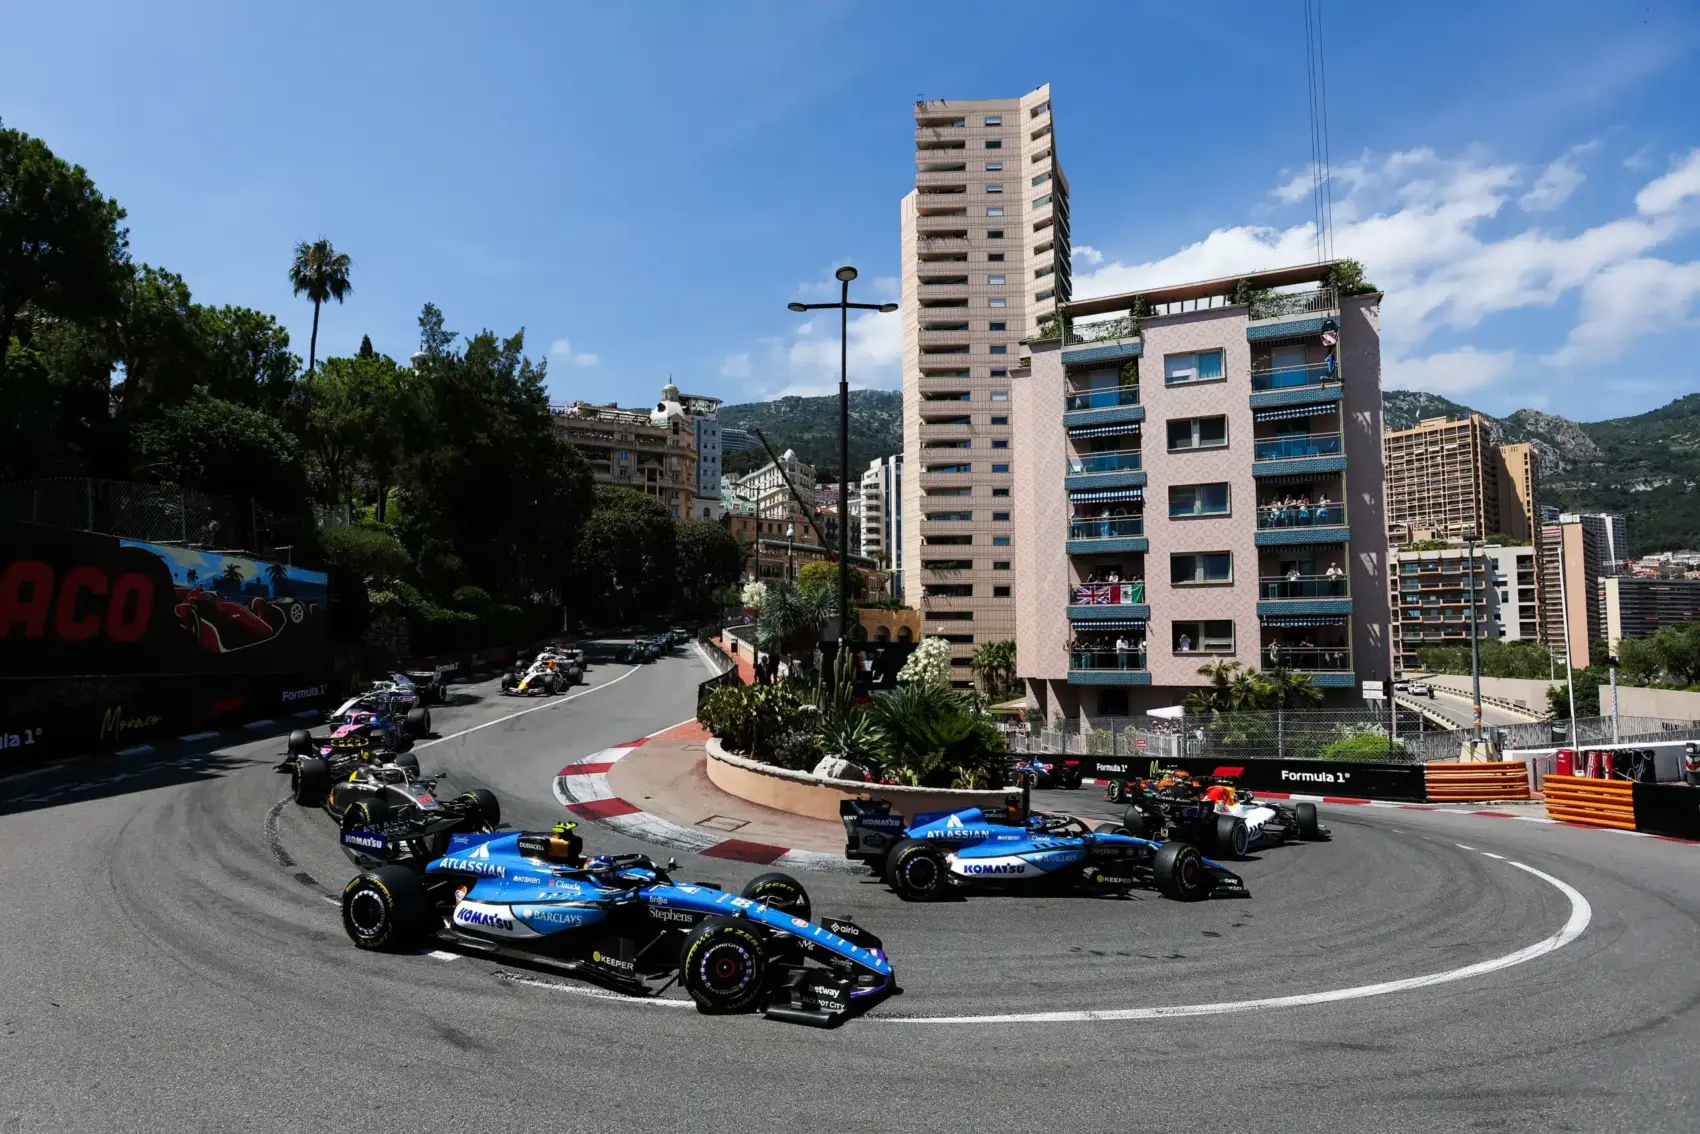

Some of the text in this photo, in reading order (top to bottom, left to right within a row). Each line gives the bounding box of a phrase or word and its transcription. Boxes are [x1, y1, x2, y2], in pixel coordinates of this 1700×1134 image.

[282, 686, 318, 703] Formula
[100, 705, 163, 741] Monaco
[1096, 762, 1120, 772] Formula
[1281, 770, 1334, 783] Formula
[862, 818, 900, 827] KOMATSU
[926, 828, 990, 840] ATLASSIAN
[344, 834, 383, 849] KOMATSU
[519, 842, 545, 851] DURACELL
[440, 857, 506, 879] ATLASSIAN
[963, 862, 1025, 874] KOMATSU
[555, 879, 581, 891] Claude
[457, 907, 513, 931] KOMATSU
[534, 910, 583, 926] BARCLAYS
[648, 906, 693, 922] Stephens
[840, 925, 859, 936] airia
[600, 955, 634, 971] KEEPER
[808, 984, 840, 999] betway
[829, 1001, 846, 1010] CITY
